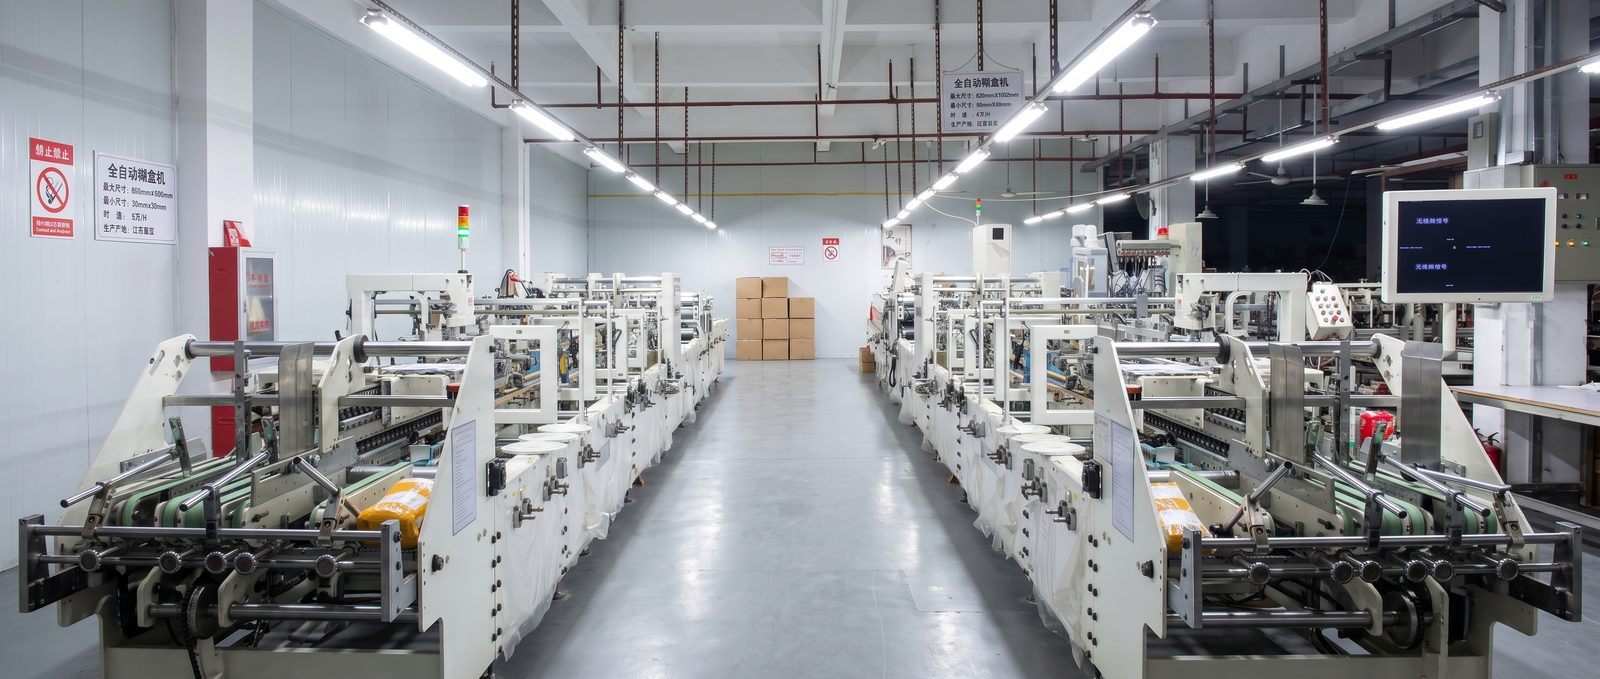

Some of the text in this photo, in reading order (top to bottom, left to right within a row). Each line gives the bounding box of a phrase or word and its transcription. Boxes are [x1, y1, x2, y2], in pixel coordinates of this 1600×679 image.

[954, 77, 1009, 89] 全自动糊盒机
[108, 163, 166, 185] 全自动糊盒机
